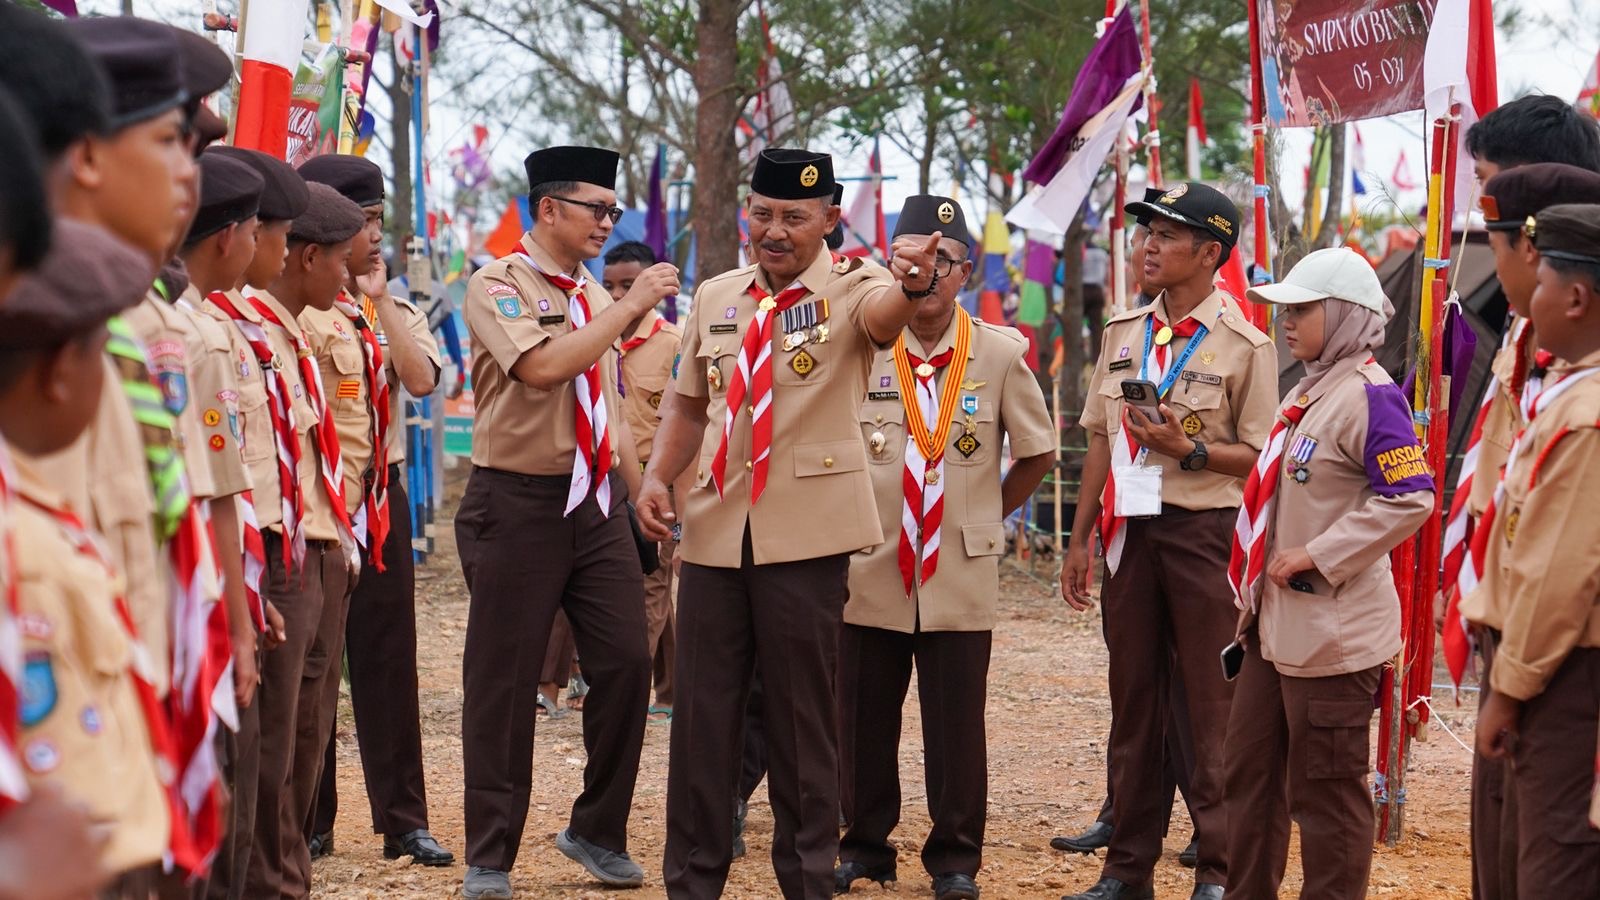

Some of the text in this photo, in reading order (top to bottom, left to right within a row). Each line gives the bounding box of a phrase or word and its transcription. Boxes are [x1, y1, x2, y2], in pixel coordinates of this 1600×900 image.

[1304, 17, 1349, 55] SMPN
[1350, 13, 1369, 48] 10
[1353, 61, 1372, 92] 05
[1380, 56, 1404, 89] 031
